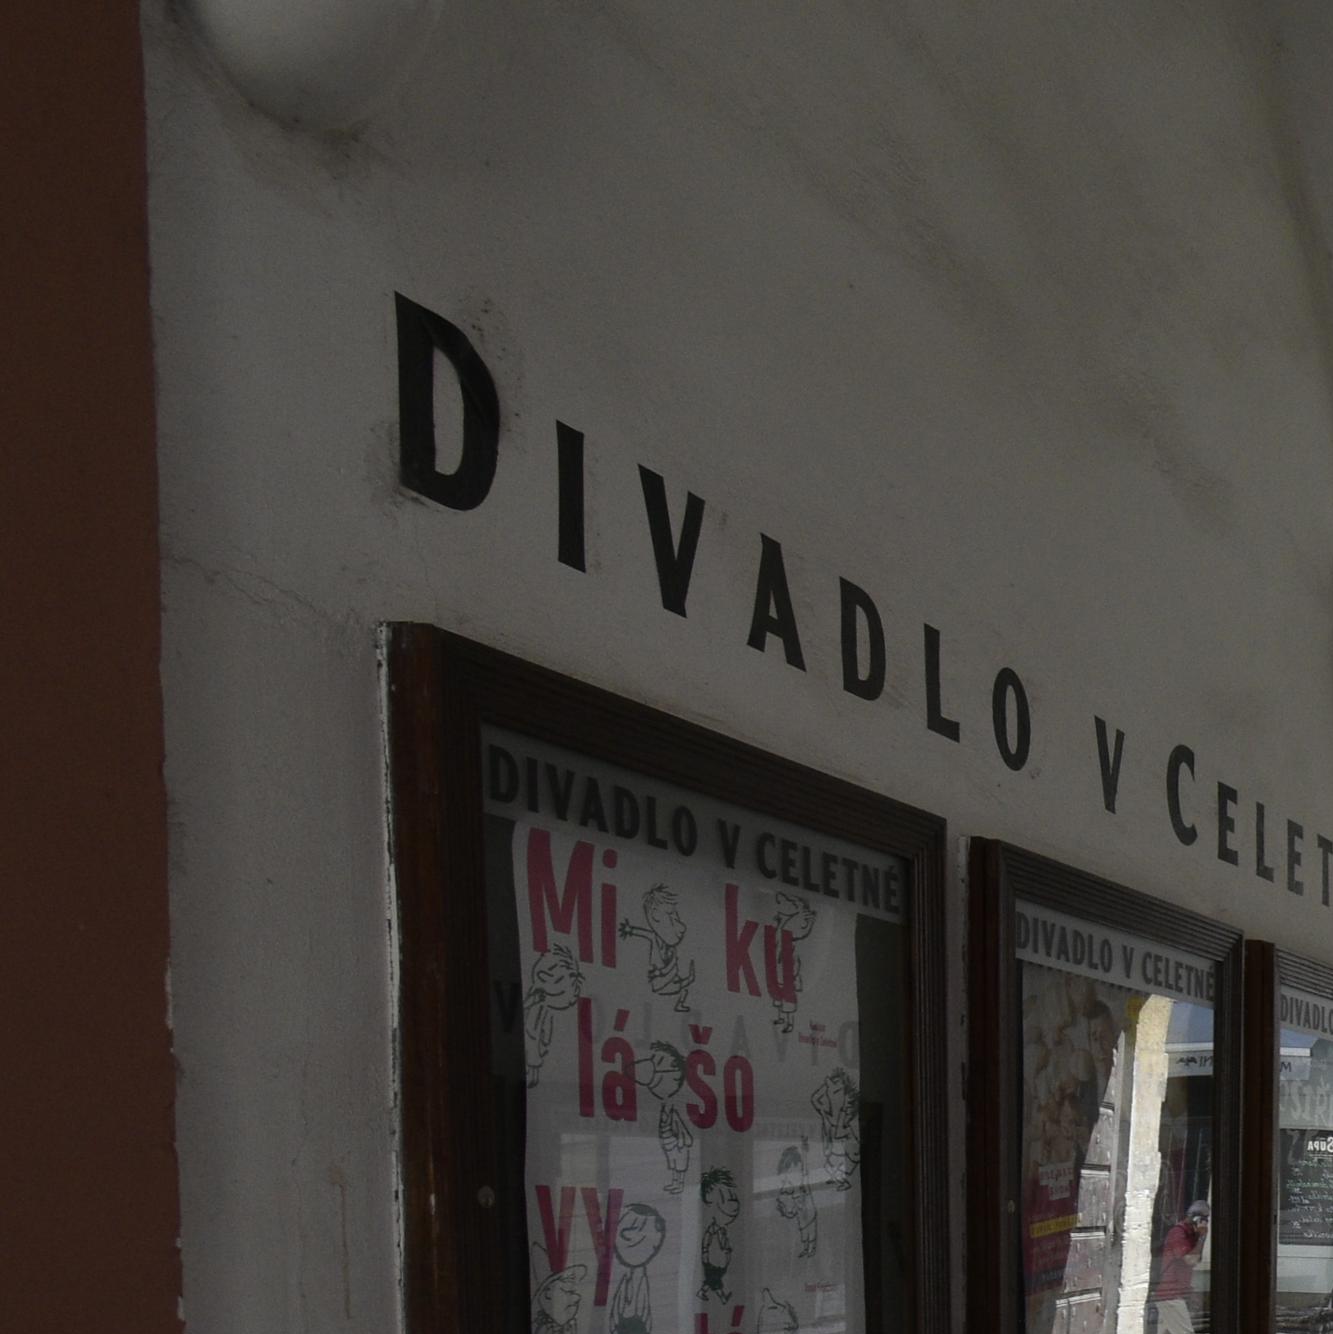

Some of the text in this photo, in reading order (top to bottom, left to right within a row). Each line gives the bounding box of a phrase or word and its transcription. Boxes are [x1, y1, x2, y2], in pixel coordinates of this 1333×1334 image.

[395, 291, 1031, 771] DIVADLO
[1094, 716, 1125, 814] V
[488, 744, 898, 913] DIVADLO V CELETNÉ
[527, 827, 798, 1004] Mi ku
[1016, 911, 1214, 1001] DIVADLO V CELETNÉ
[577, 997, 754, 1133] lá šo
[536, 1185, 624, 1306] vy
